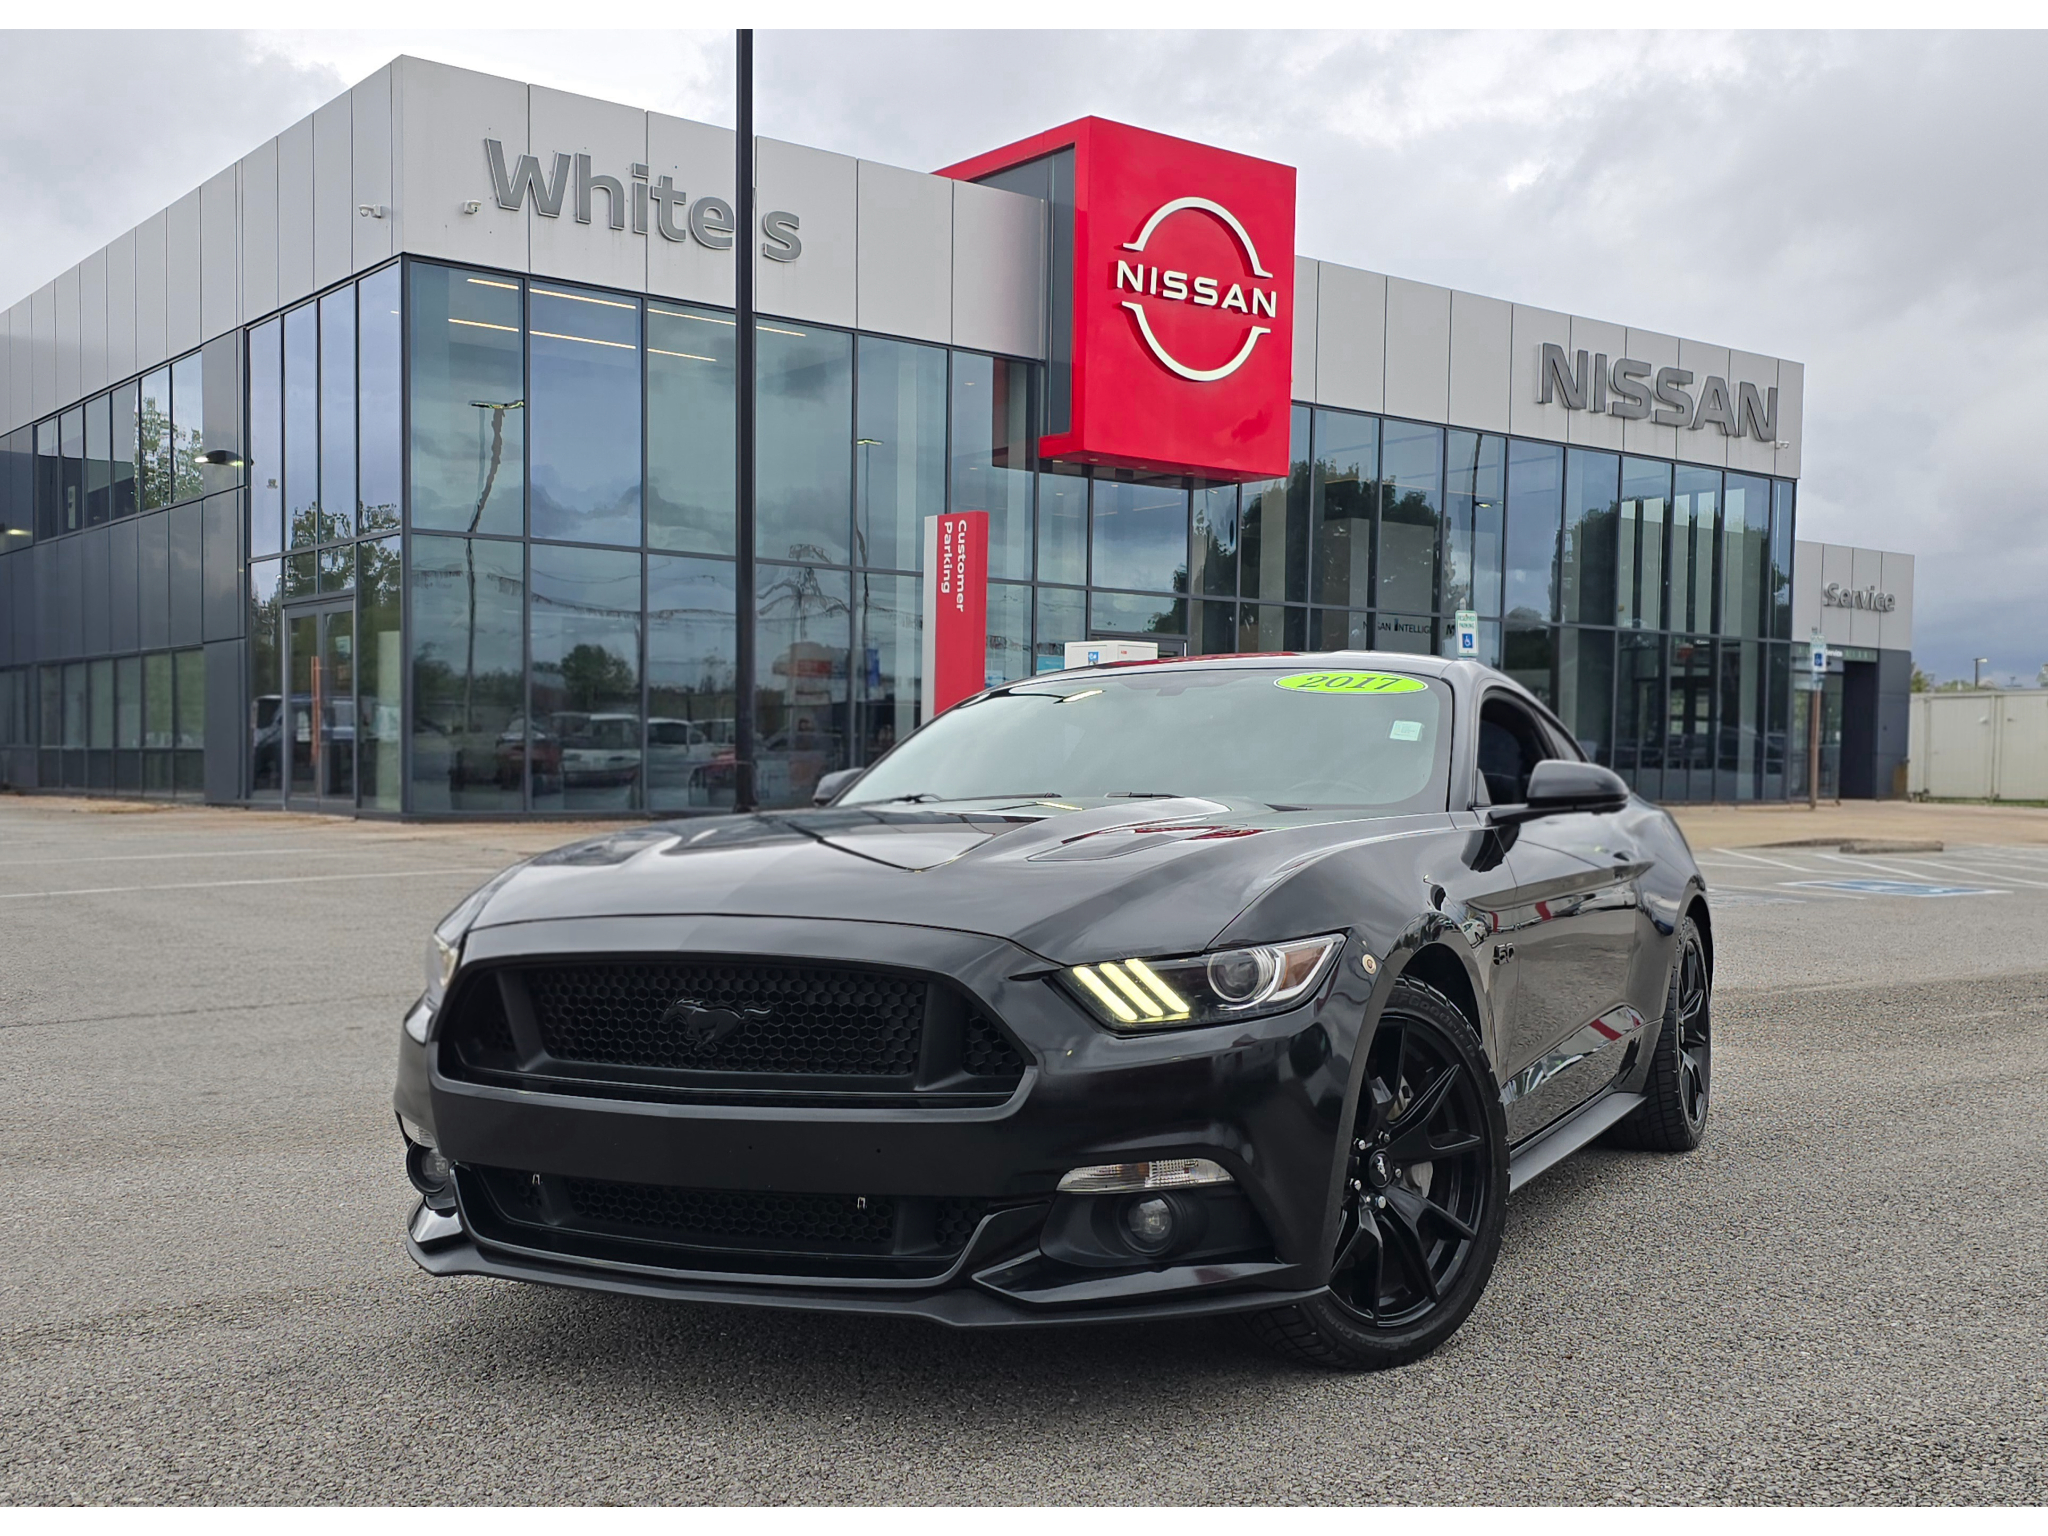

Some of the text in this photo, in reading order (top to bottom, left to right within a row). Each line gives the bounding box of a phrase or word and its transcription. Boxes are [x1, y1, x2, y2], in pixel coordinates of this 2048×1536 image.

[485, 137, 802, 262] Whites
[1116, 260, 1277, 318] NISSAN
[1537, 342, 1778, 442] NISSAN
[941, 521, 953, 593] Parking
[956, 519, 967, 613] Customer
[1823, 582, 1896, 613] Service
[1297, 675, 1402, 690] 2017
